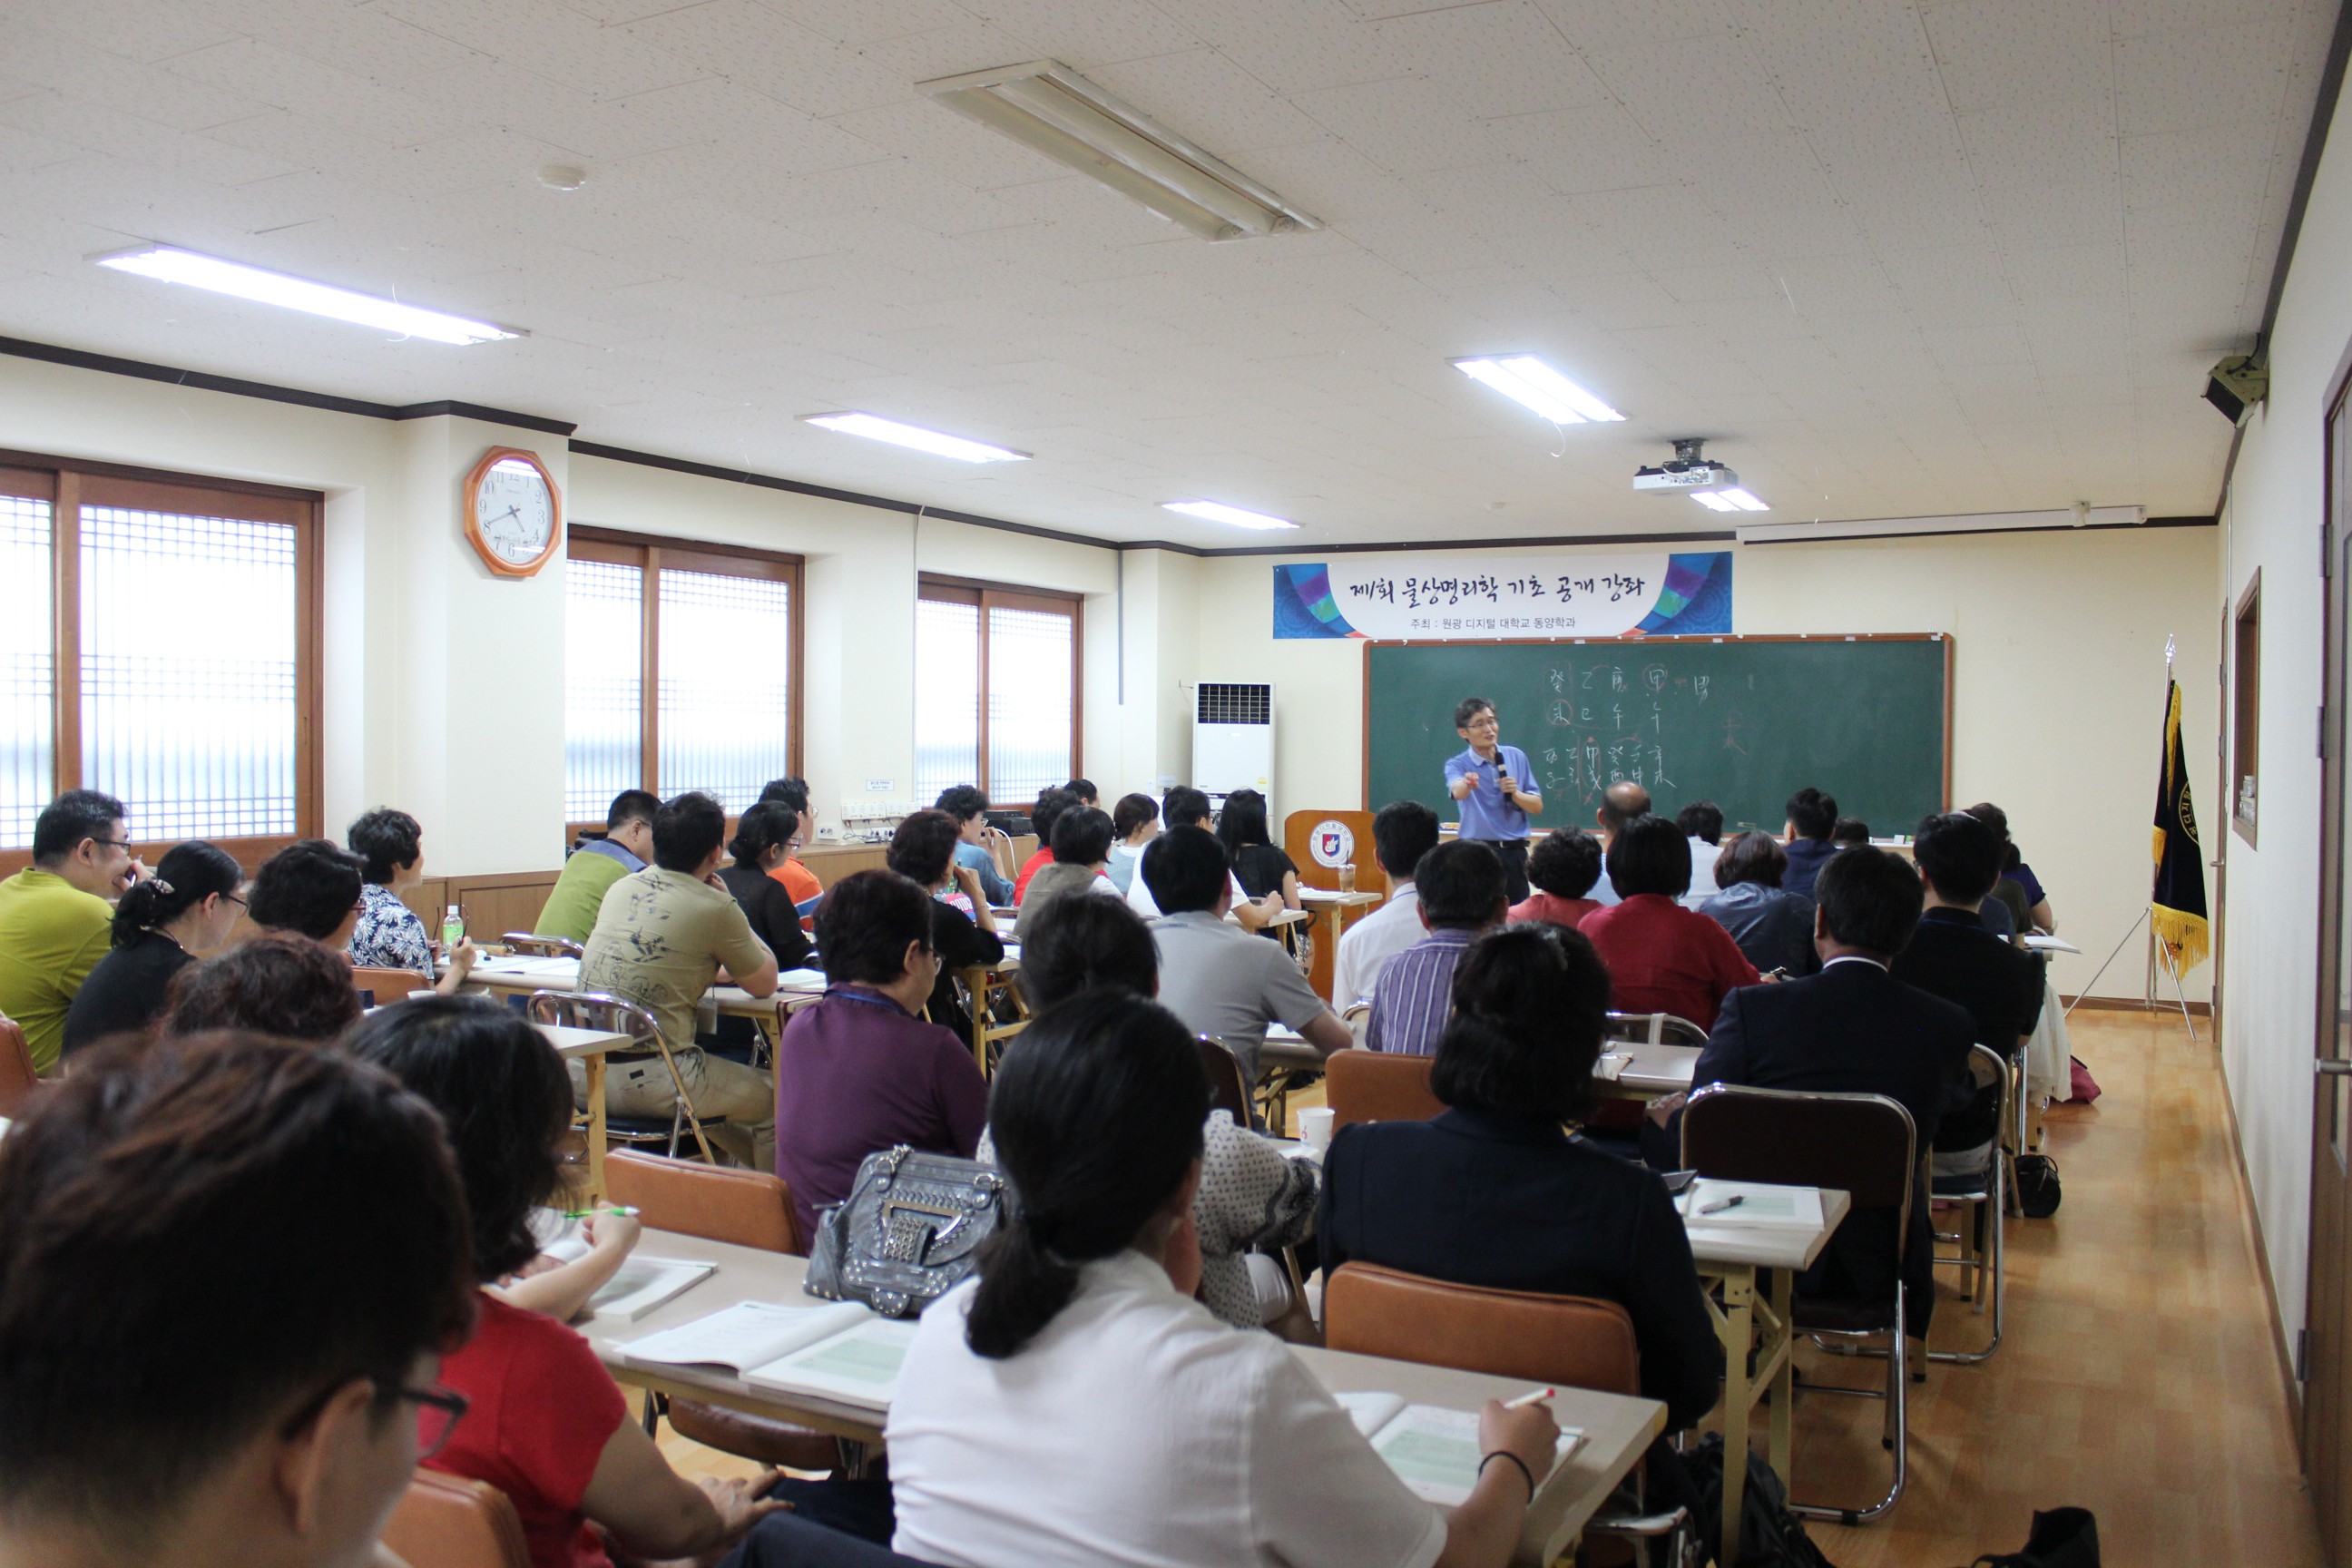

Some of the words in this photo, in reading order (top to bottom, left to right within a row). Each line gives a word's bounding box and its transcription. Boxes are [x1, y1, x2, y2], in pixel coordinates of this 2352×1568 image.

[485, 480, 495, 495] 10
[1401, 574, 1499, 609] 물상명리학
[1507, 574, 1546, 598] 기초
[1556, 575, 1594, 603] 공개
[1601, 573, 1646, 603] 강좌
[1442, 618, 1463, 630] 원광
[1465, 617, 1496, 630] 디지털
[1500, 617, 1531, 629] 대학교
[1534, 616, 1576, 629] 동양학과
